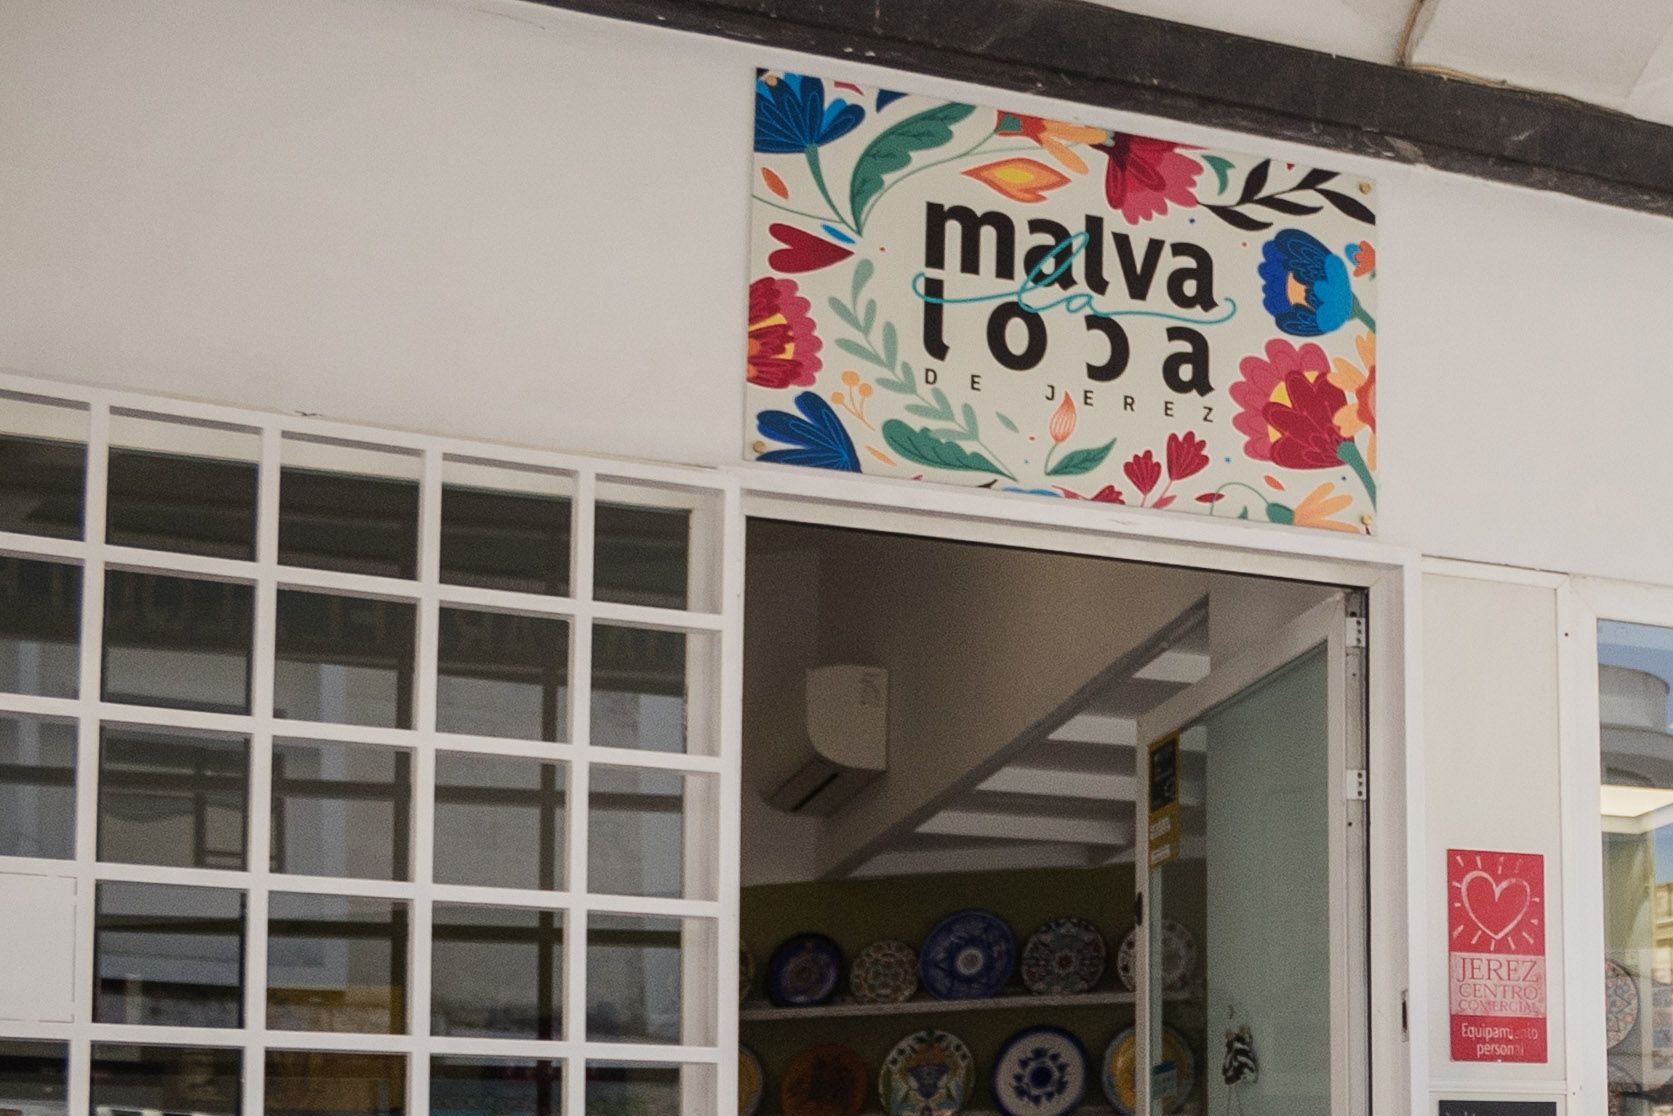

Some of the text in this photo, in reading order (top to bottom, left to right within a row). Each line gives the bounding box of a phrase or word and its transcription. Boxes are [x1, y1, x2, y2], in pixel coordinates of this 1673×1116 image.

[925, 201, 1219, 312] malva
[924, 368, 1214, 423] DE JEREZ
[1457, 957, 1539, 983] JEREZ
[1458, 983, 1538, 1000] CENTRO
